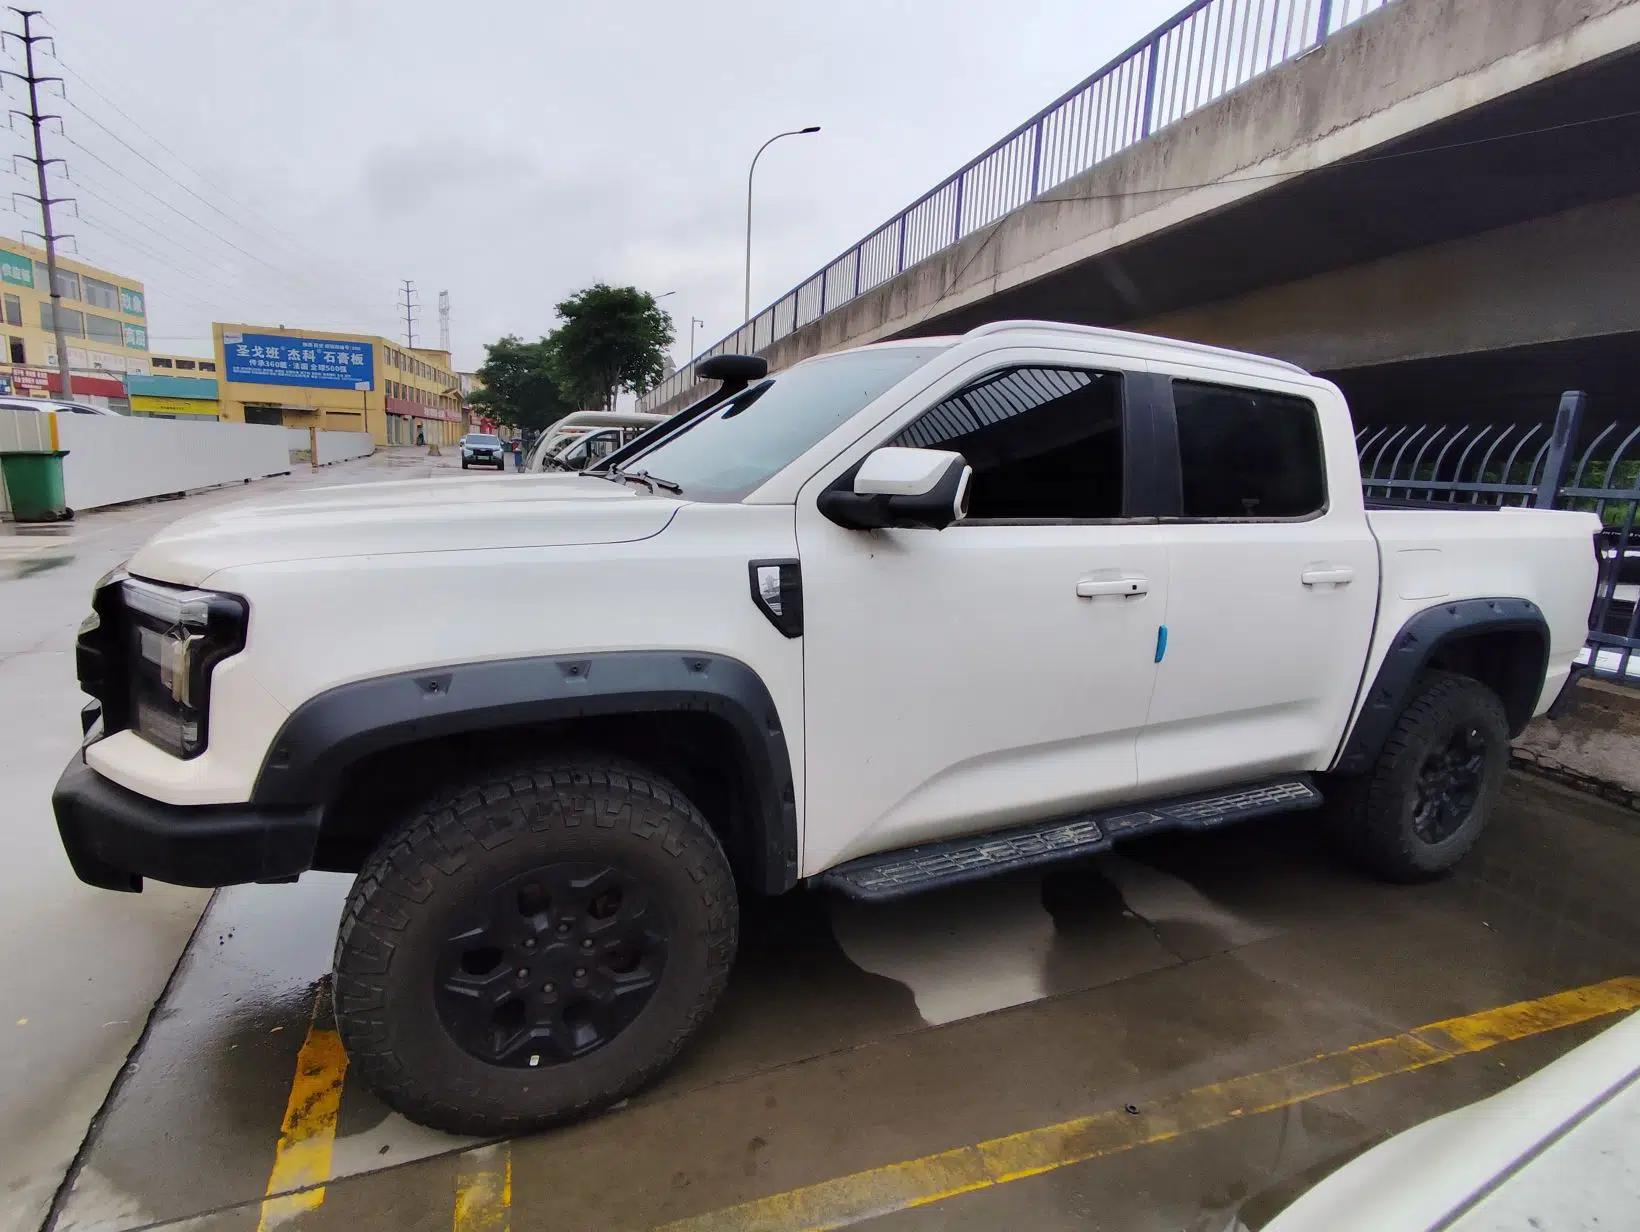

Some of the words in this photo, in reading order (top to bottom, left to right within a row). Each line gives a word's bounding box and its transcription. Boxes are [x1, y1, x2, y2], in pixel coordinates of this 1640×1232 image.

[236, 344, 280, 360] 圣戈班
[287, 348, 316, 362] 杰科
[323, 351, 364, 366] 石膏板
